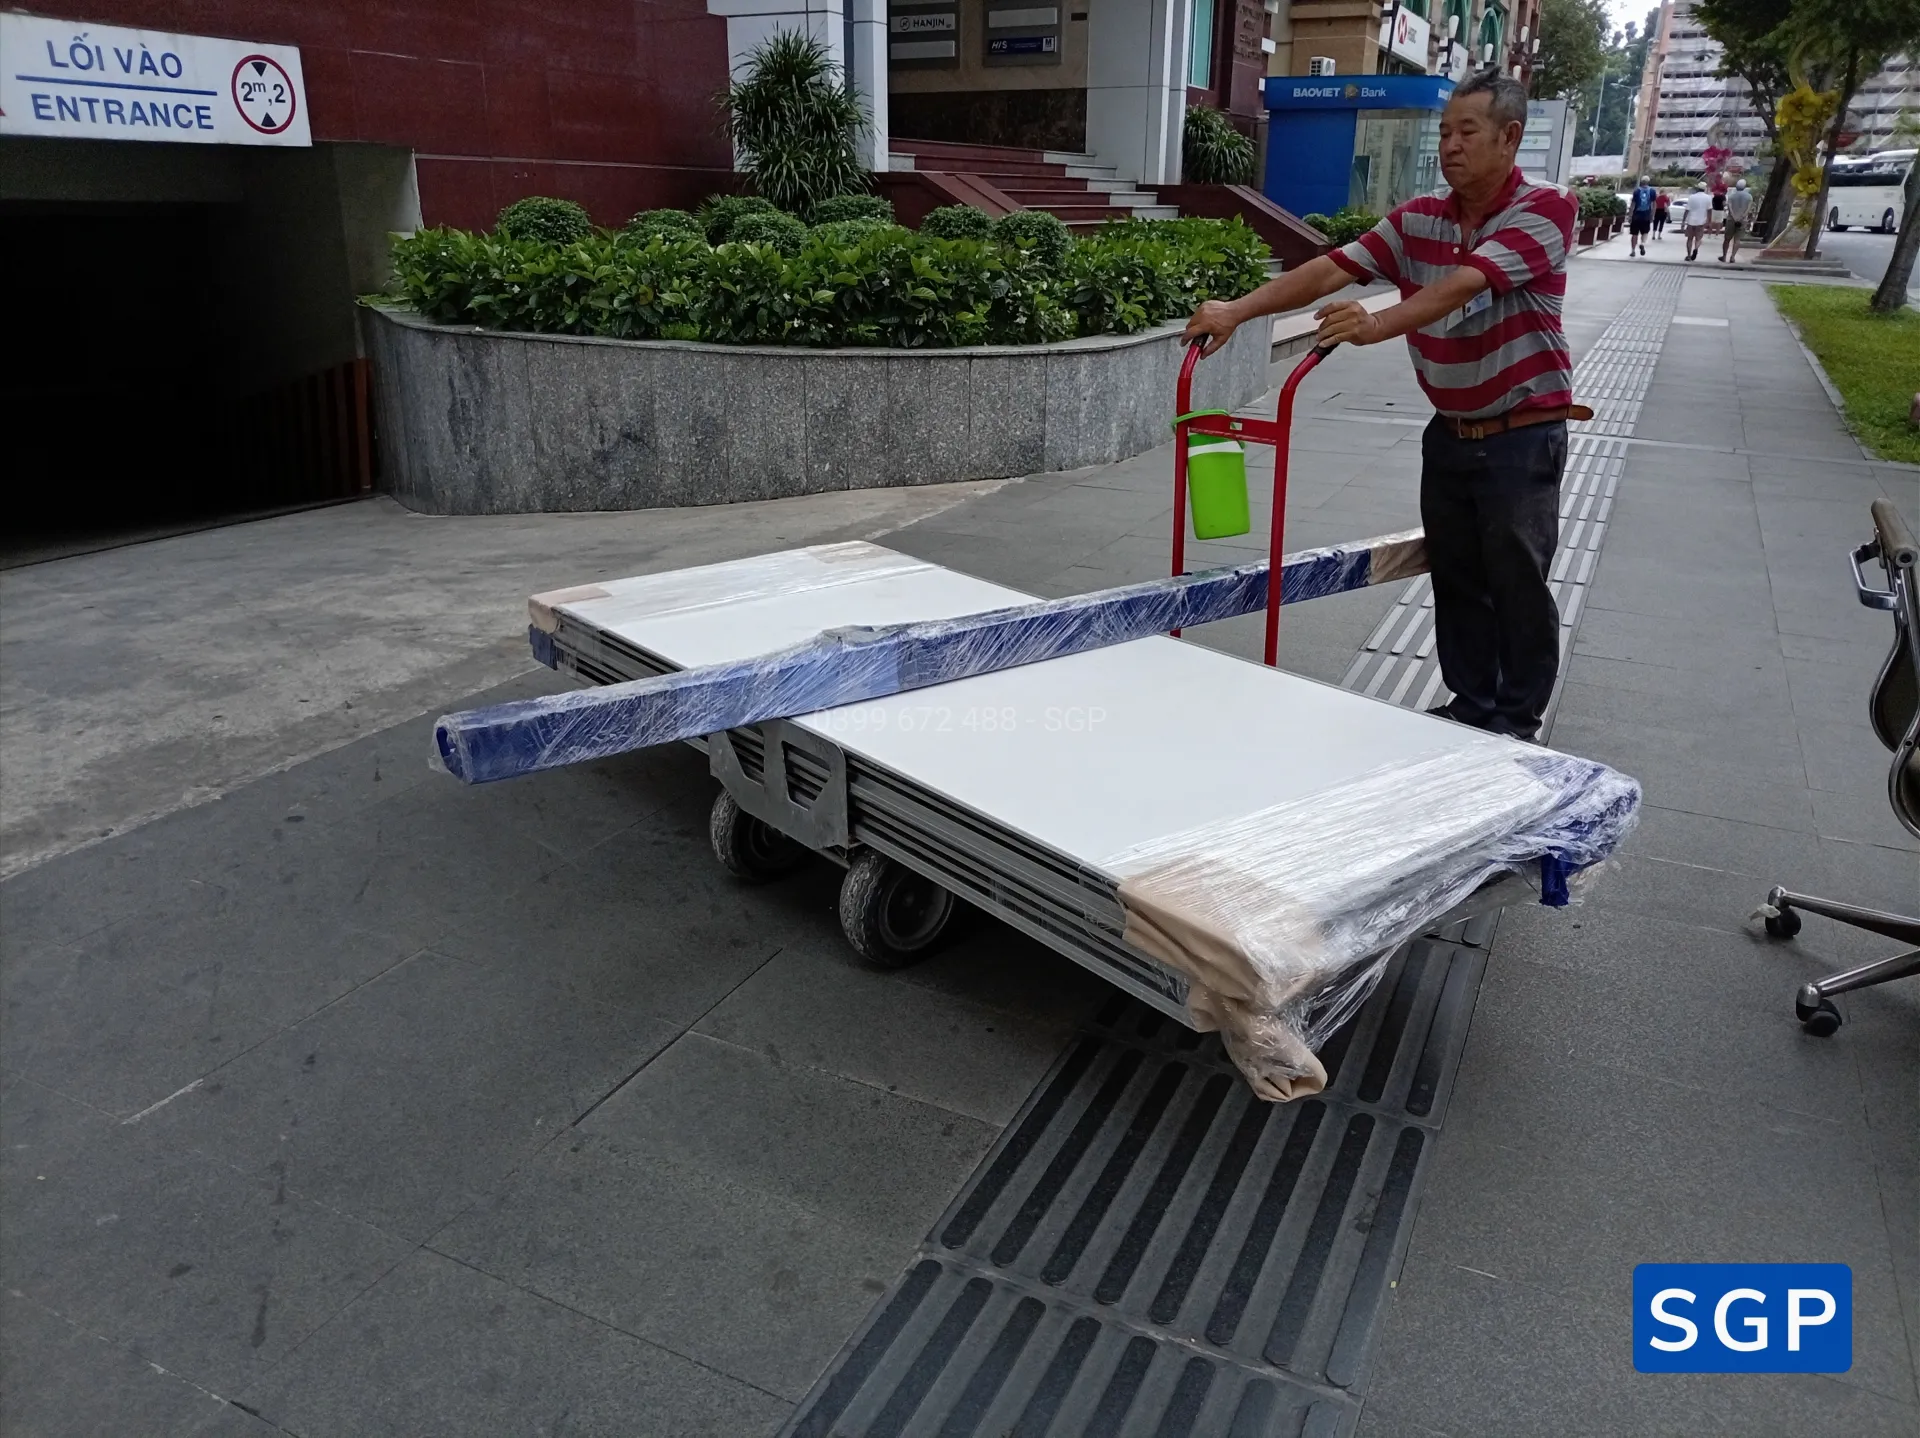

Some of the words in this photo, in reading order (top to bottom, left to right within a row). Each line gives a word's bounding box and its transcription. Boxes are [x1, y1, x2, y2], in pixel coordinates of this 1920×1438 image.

[913, 18, 945, 29] HANJIN
[46, 32, 105, 72] LỐI
[113, 43, 183, 79] VÀO
[1293, 87, 1341, 98] BAOVIET
[1361, 87, 1387, 98] Bank
[30, 93, 214, 130] ENTRANCE
